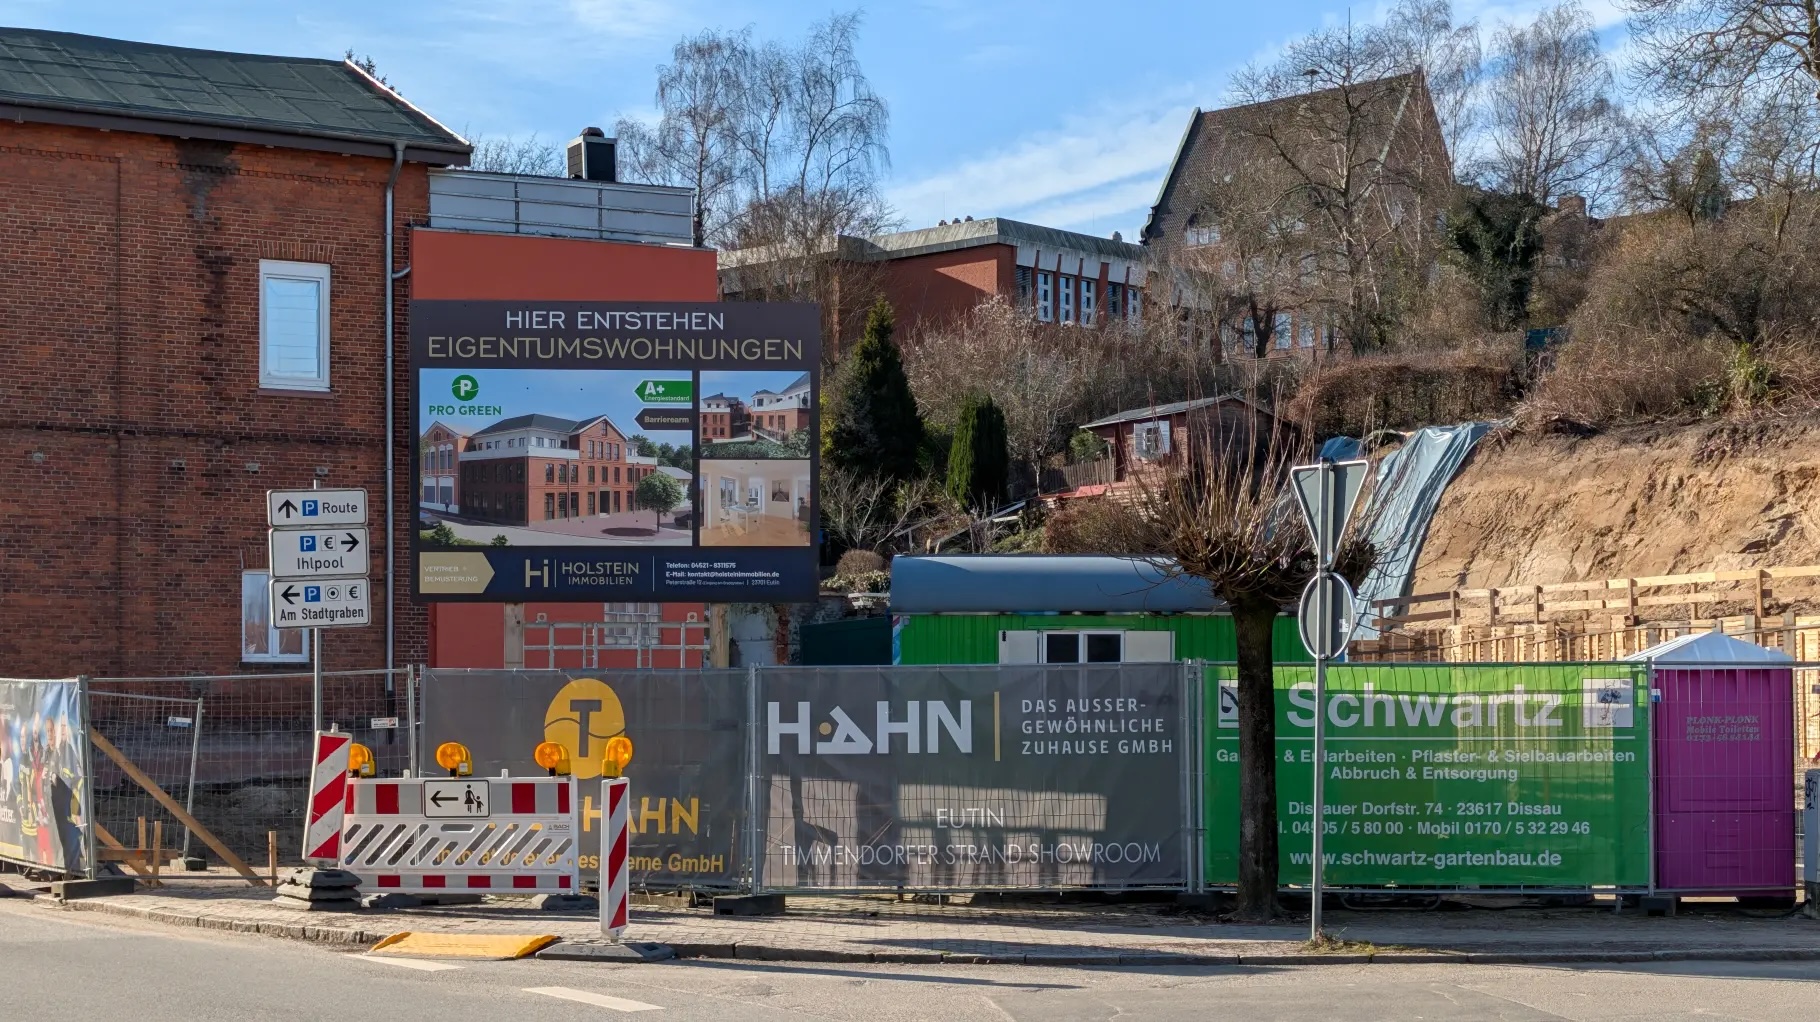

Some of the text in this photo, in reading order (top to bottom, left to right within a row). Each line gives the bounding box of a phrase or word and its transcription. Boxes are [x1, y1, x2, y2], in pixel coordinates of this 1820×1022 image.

[506, 311, 724, 330] HIER ENTSTEHEN
[428, 336, 802, 361] EIGENTUMSWOHNUNGEN
[644, 381, 665, 396] A+
[428, 405, 502, 416] PRO GREEN
[644, 416, 690, 424] Barrierearm
[322, 502, 358, 514] Route
[297, 556, 344, 572] Ihlpool
[525, 559, 640, 588] Hi HOLSTEIN
[568, 576, 633, 585] IMMOBILIEN
[280, 606, 364, 622] Am Stadtgraben
[1022, 698, 1146, 713] DAS AUSSER-
[1286, 681, 1563, 728] Schwartz
[1022, 716, 1165, 734] GEWÖHNLICHE
[1686, 724, 1760, 734] Mobile Toiletten
[1022, 739, 1173, 755] ZUHAUSE GMBH
[1284, 749, 1295, 762] &
[1412, 749, 1481, 763] Pflaster-
[1487, 750, 1500, 763] &
[1504, 750, 1636, 763] Sielbauarbeiten
[1331, 766, 1519, 782] Abbruch & Entsorgung
[1288, 801, 1562, 816] Disauer Dorfstr. 74 23617 Dissau
[936, 807, 1004, 829] EUTIN
[1417, 821, 1460, 835] Mobil
[1464, 821, 1501, 835] 0170
[780, 842, 1161, 865] TIMMENDORFER STRAND SHOWROOM
[1289, 850, 1562, 869] www.schwartz-gartenbau.de
[668, 853, 724, 873] GmbH
